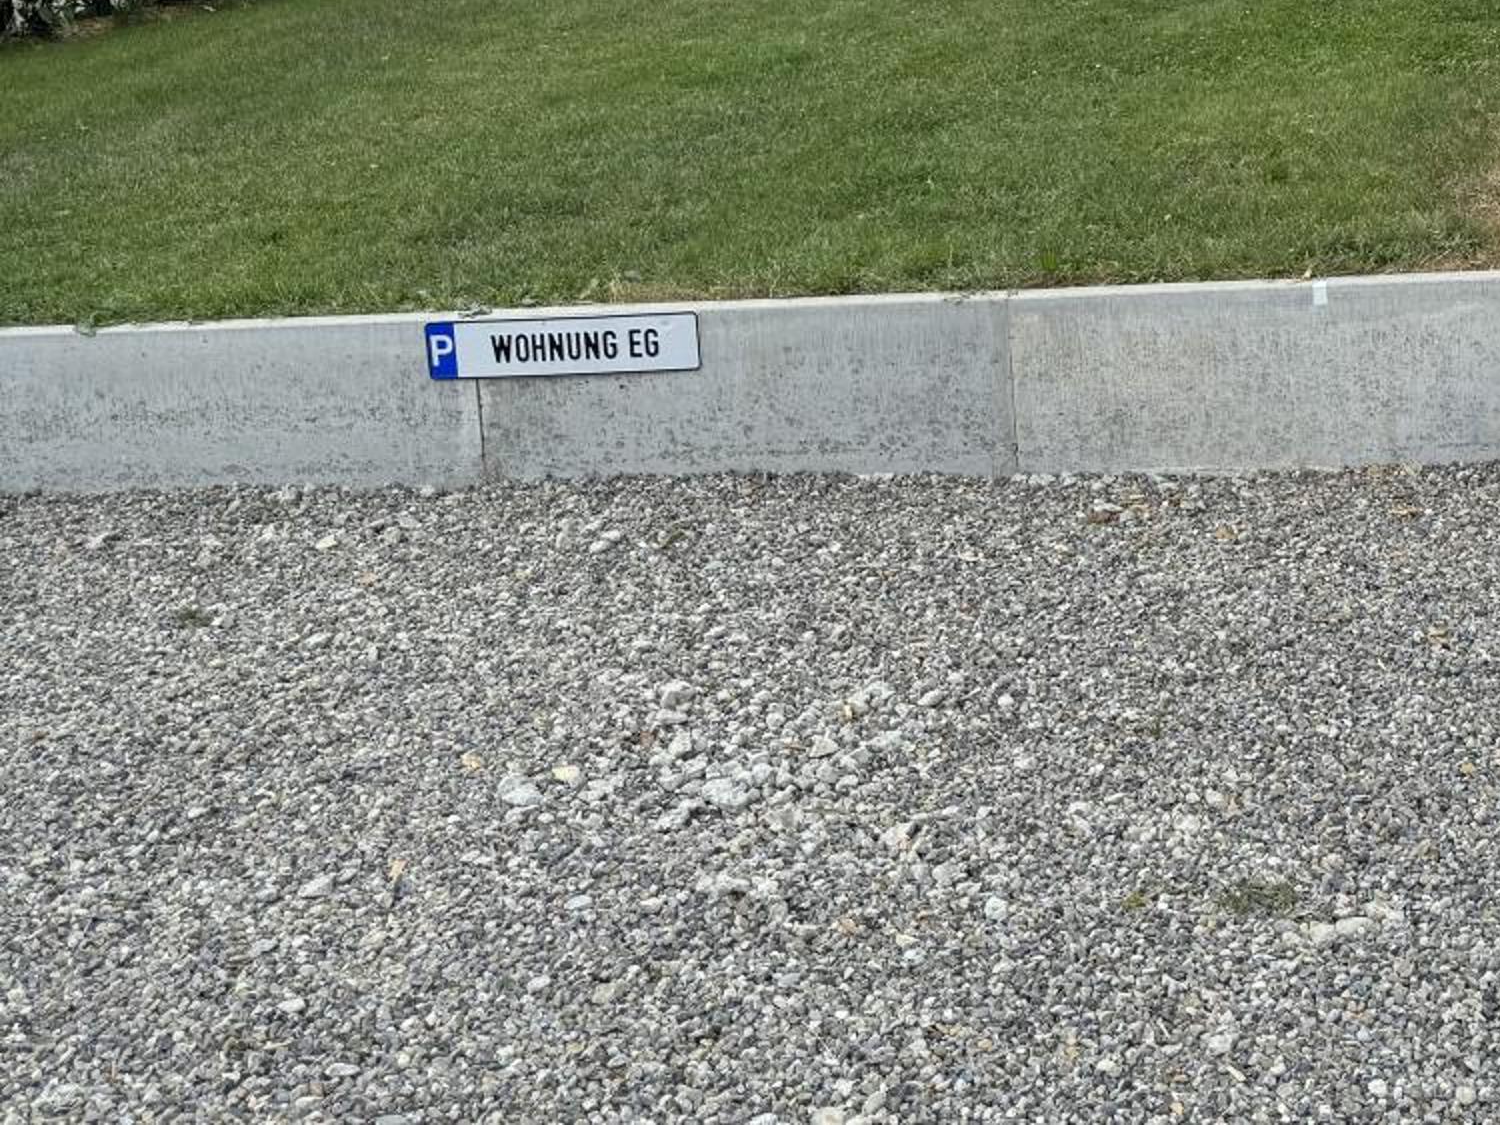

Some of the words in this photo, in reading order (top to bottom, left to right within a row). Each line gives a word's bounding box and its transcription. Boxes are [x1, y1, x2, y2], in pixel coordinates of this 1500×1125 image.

[430, 335, 453, 367] P
[491, 330, 617, 363] WOHNUNG
[629, 329, 660, 357] EG
